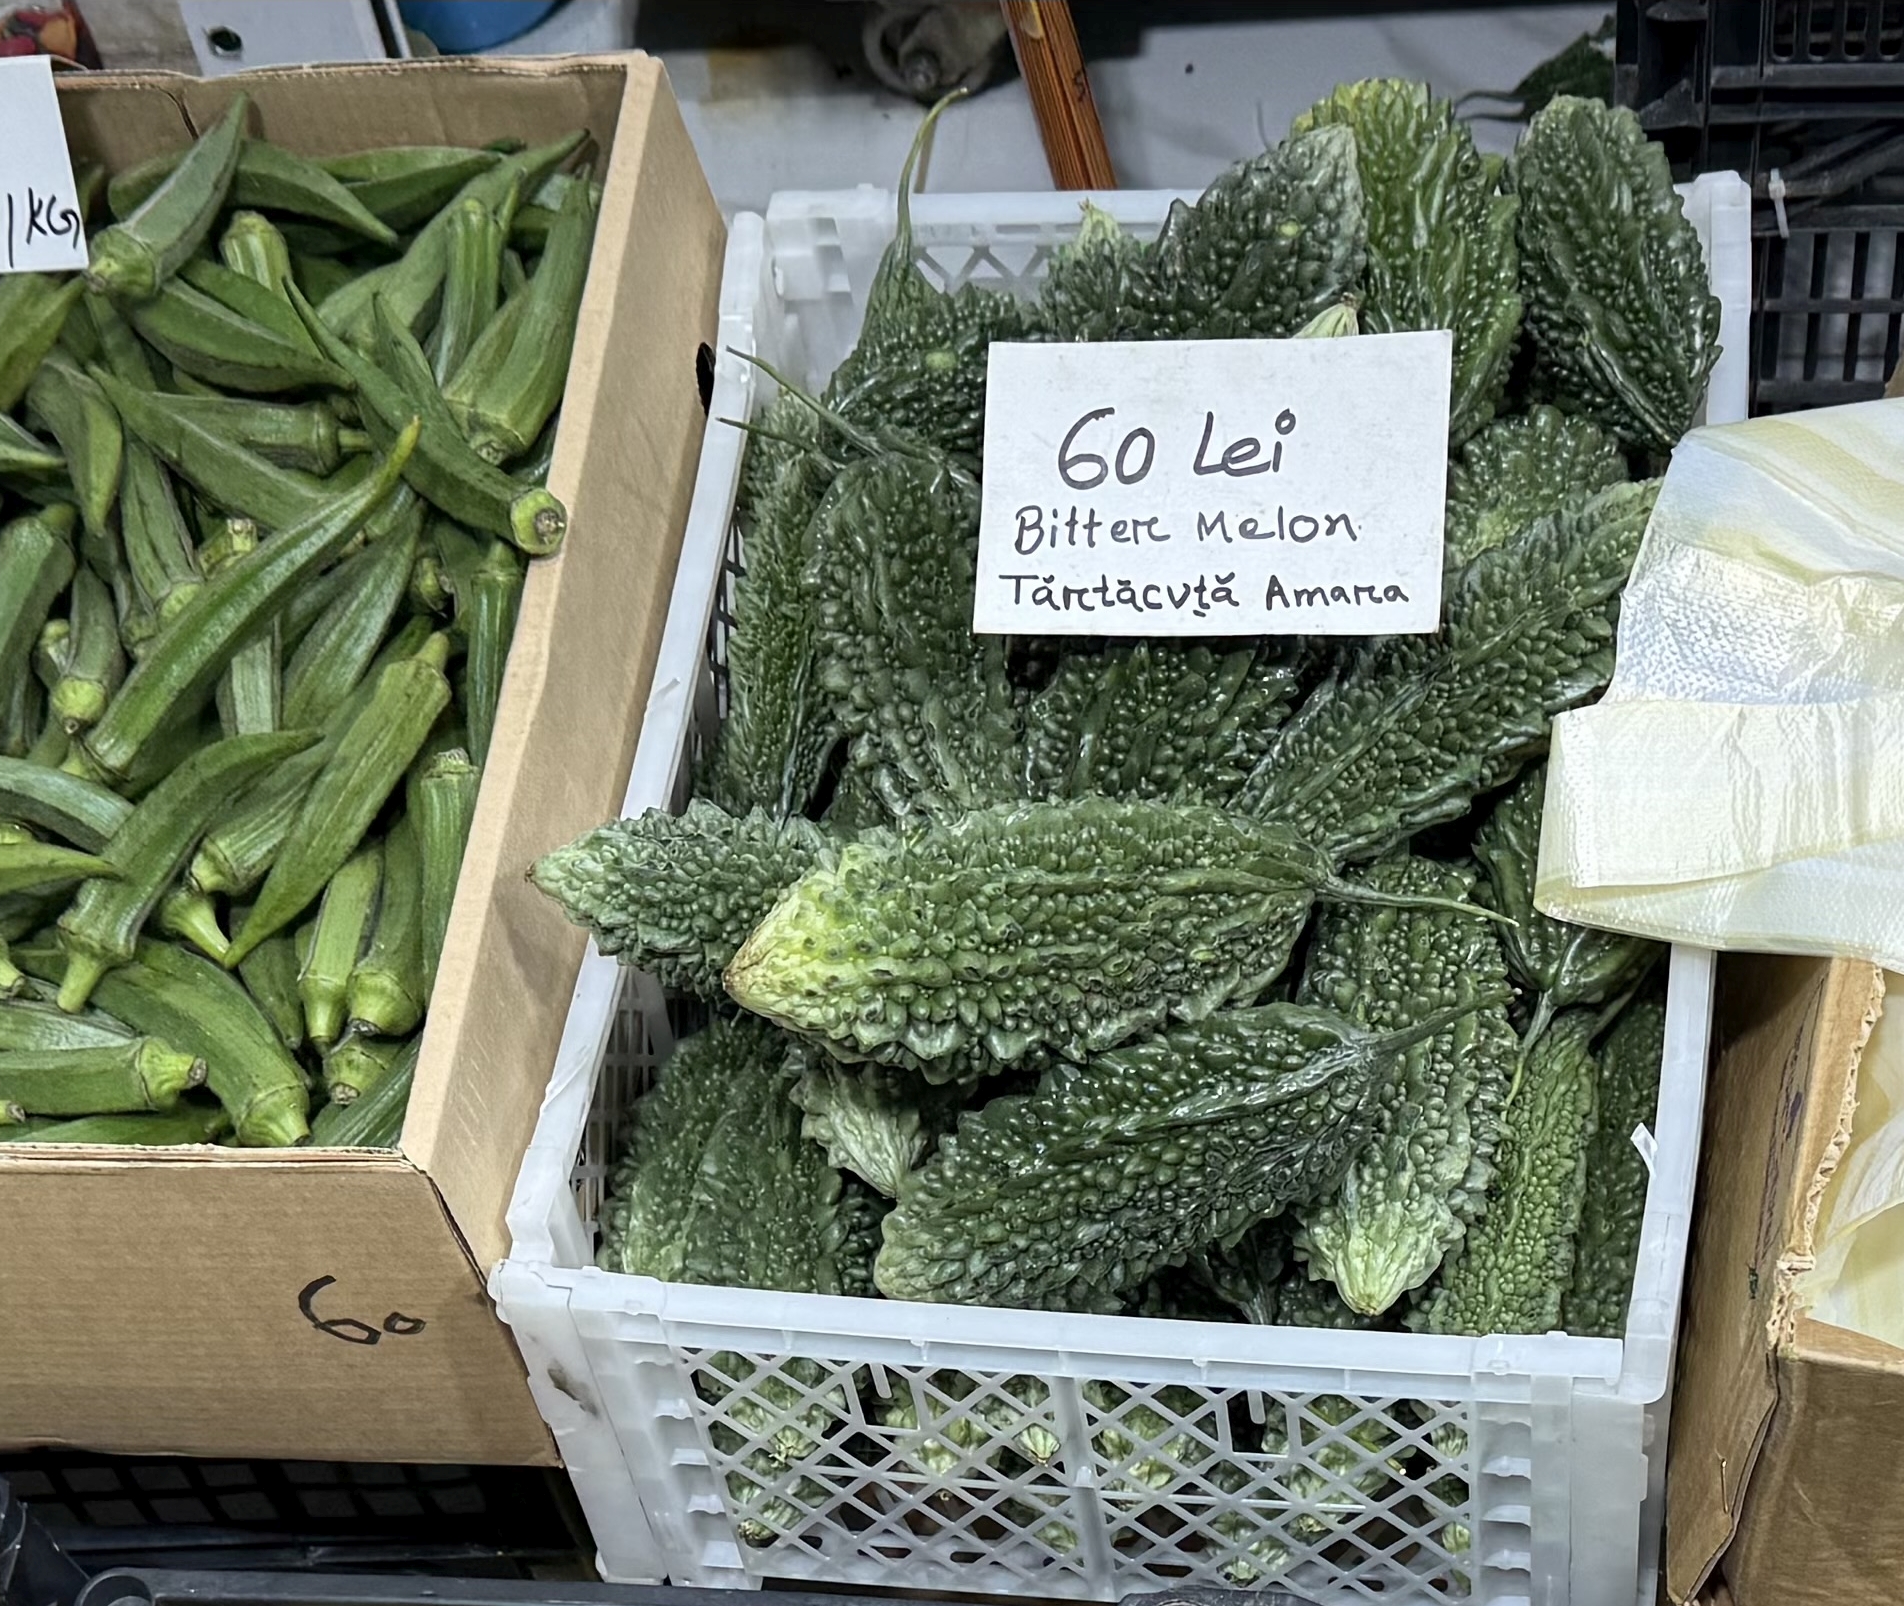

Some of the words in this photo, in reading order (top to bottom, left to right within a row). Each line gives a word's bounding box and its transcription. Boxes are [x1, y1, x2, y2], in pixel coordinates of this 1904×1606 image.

[1057, 406, 1156, 491] 60
[1193, 408, 1297, 477] Lei
[1014, 505, 1171, 555] Bitter
